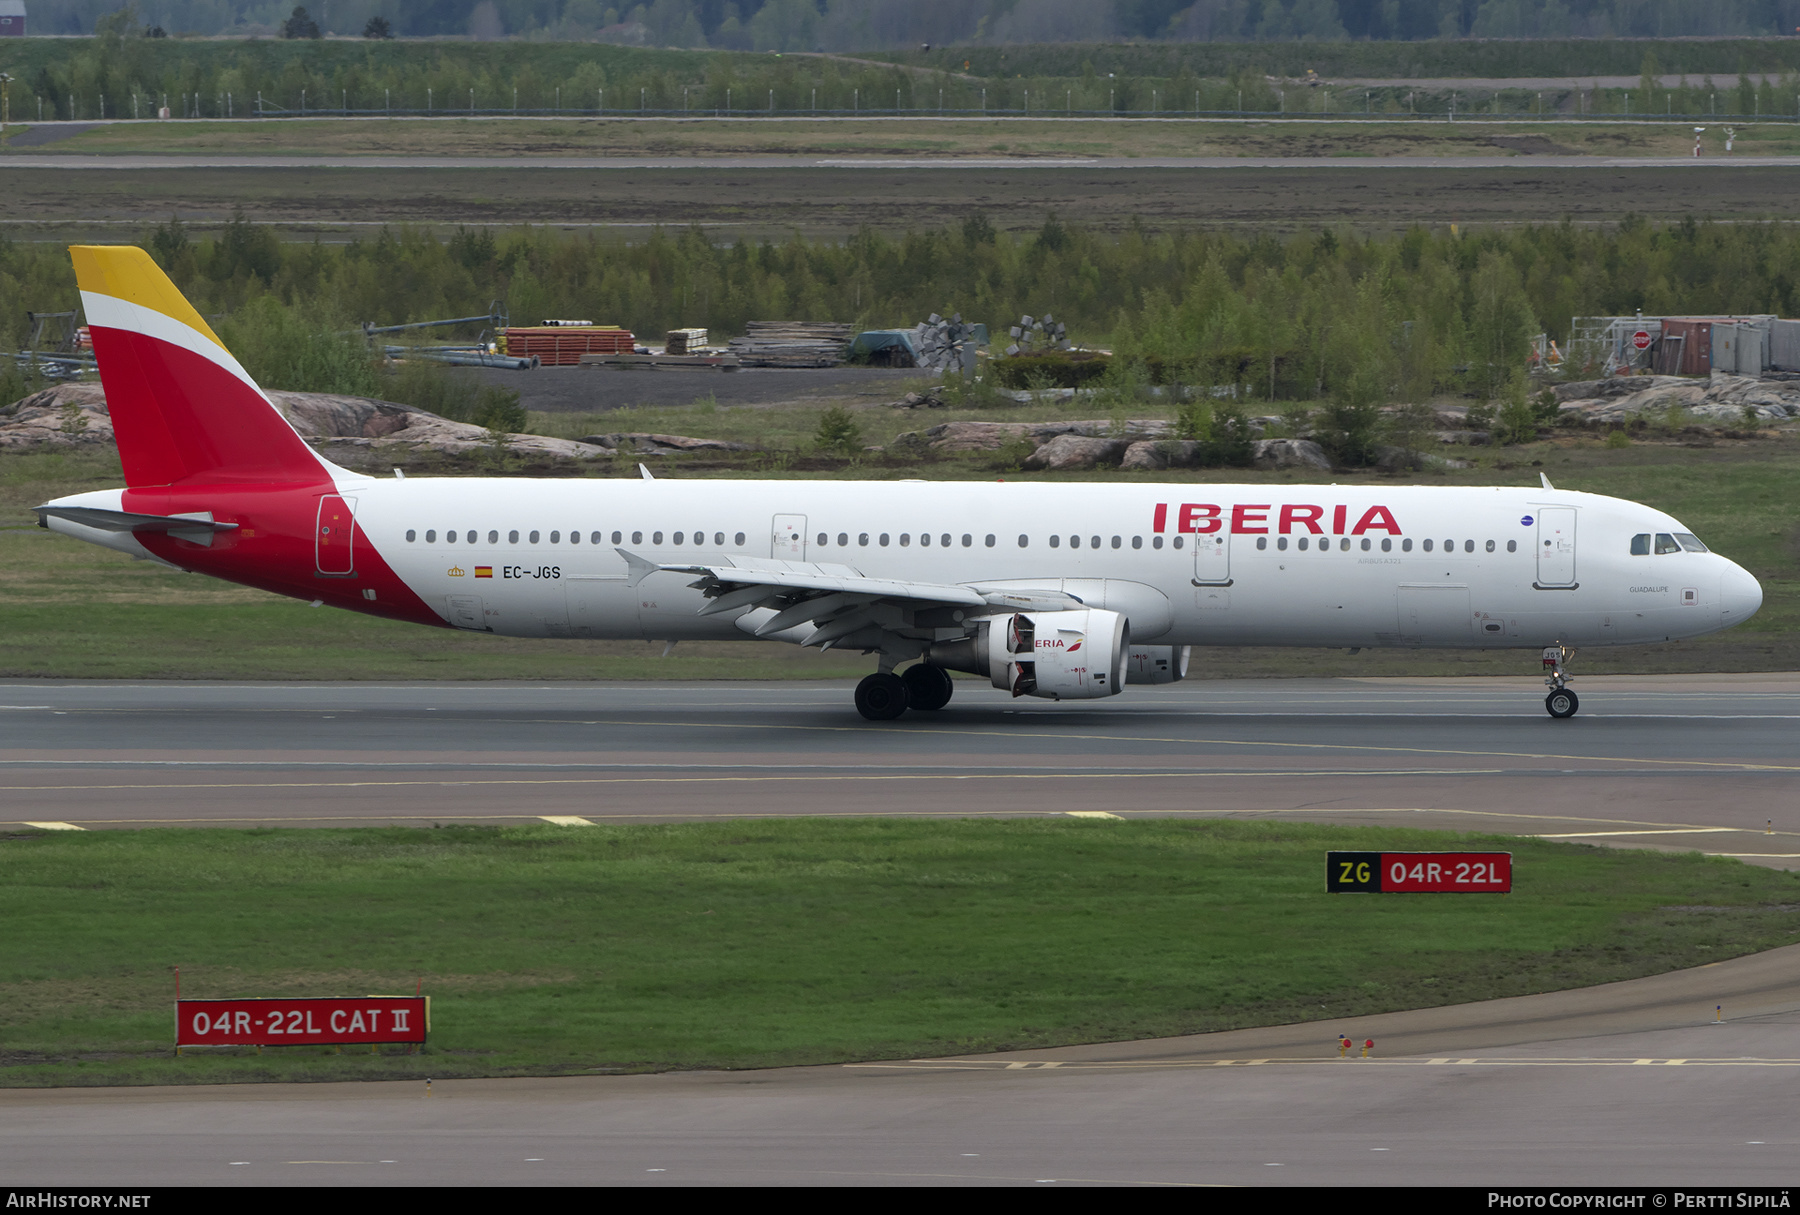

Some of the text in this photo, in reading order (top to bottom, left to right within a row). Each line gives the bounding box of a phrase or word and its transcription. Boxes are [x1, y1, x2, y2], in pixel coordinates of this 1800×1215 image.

[1153, 503, 1403, 535] IBERIA
[503, 565, 561, 579] EC-JGS
[1339, 862, 1503, 884] ZG 04R-22L
[192, 1009, 410, 1035] 04R-22L CAT II
